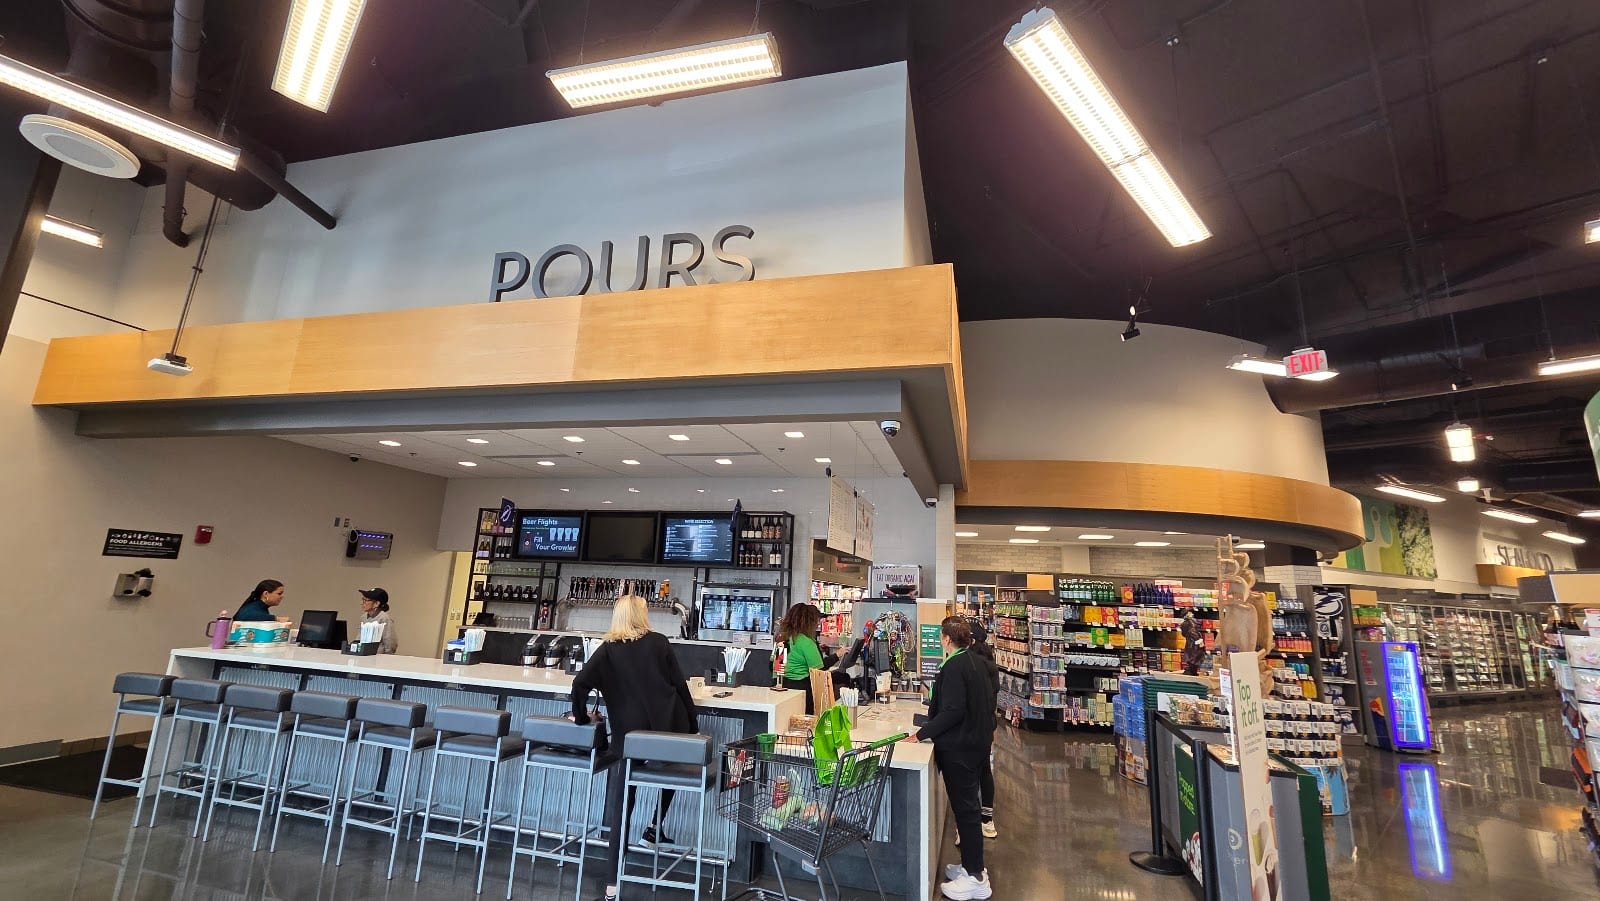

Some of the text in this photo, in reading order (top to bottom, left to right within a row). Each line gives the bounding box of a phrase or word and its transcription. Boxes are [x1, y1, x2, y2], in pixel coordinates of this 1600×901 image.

[489, 225, 755, 303] POURS
[1290, 351, 1321, 375] EXIT
[1236, 680, 1251, 706] Top
[1241, 706, 1247, 728] it
